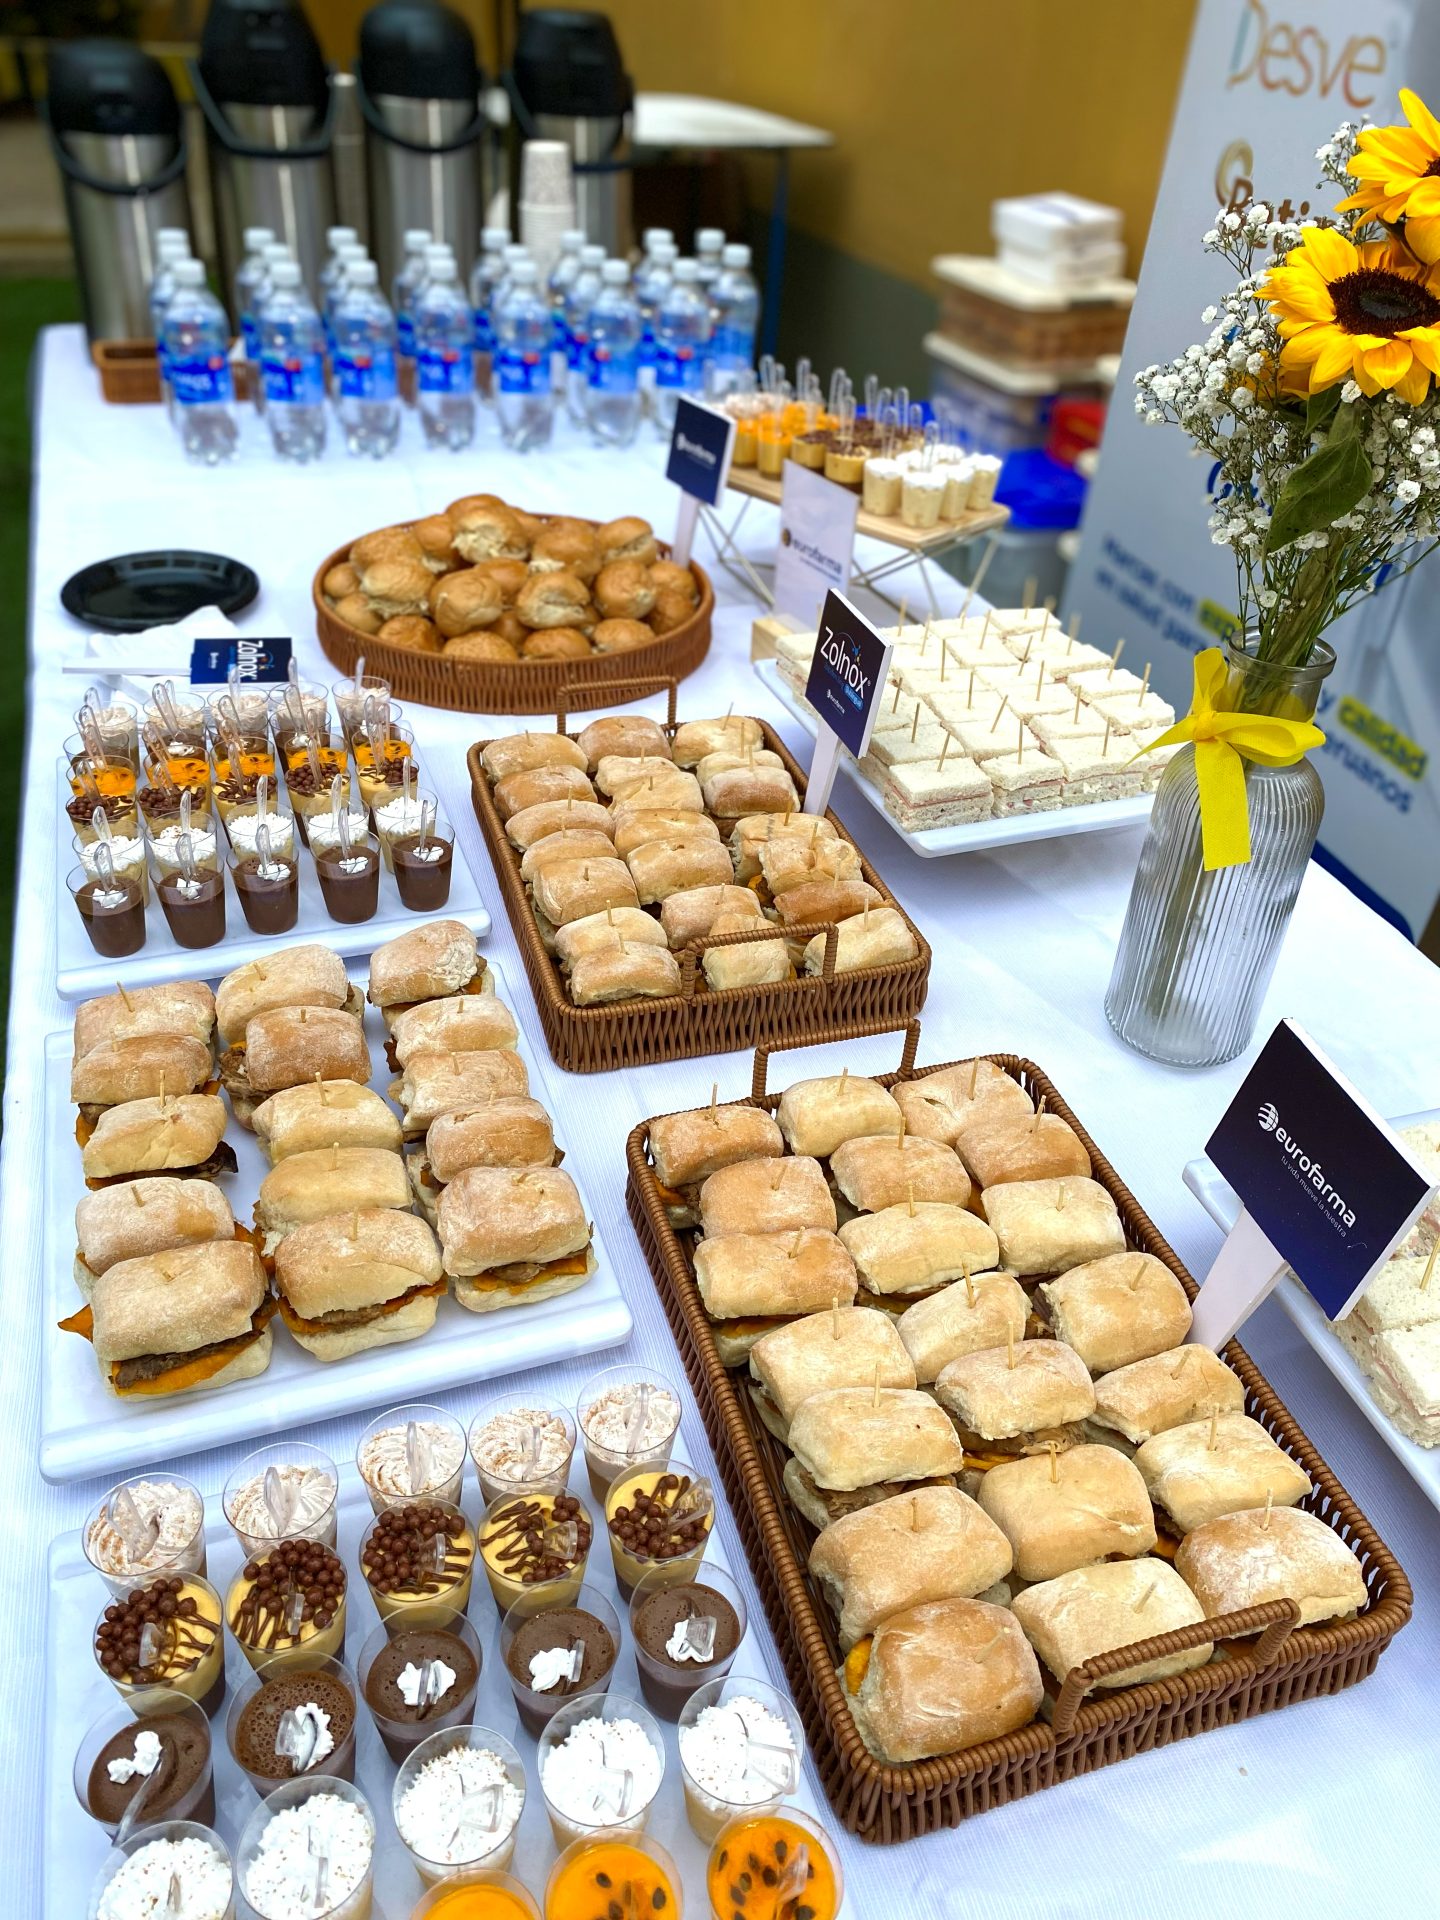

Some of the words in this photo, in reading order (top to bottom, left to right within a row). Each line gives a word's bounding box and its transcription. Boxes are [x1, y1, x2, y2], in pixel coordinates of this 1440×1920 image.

[1227, 0, 1386, 108] Desve
[237, 640, 266, 679] Zolnox
[820, 625, 865, 700] Zolnox
[1322, 730, 1413, 814] eruanos
[1338, 702, 1427, 780] calidad
[1275, 1126, 1357, 1229] eurofarma
[1281, 1155, 1289, 1166] tu
[1287, 1163, 1300, 1180] vida
[1299, 1178, 1319, 1203] mueve
[1317, 1199, 1325, 1211] la
[1323, 1208, 1347, 1238] nuestra
